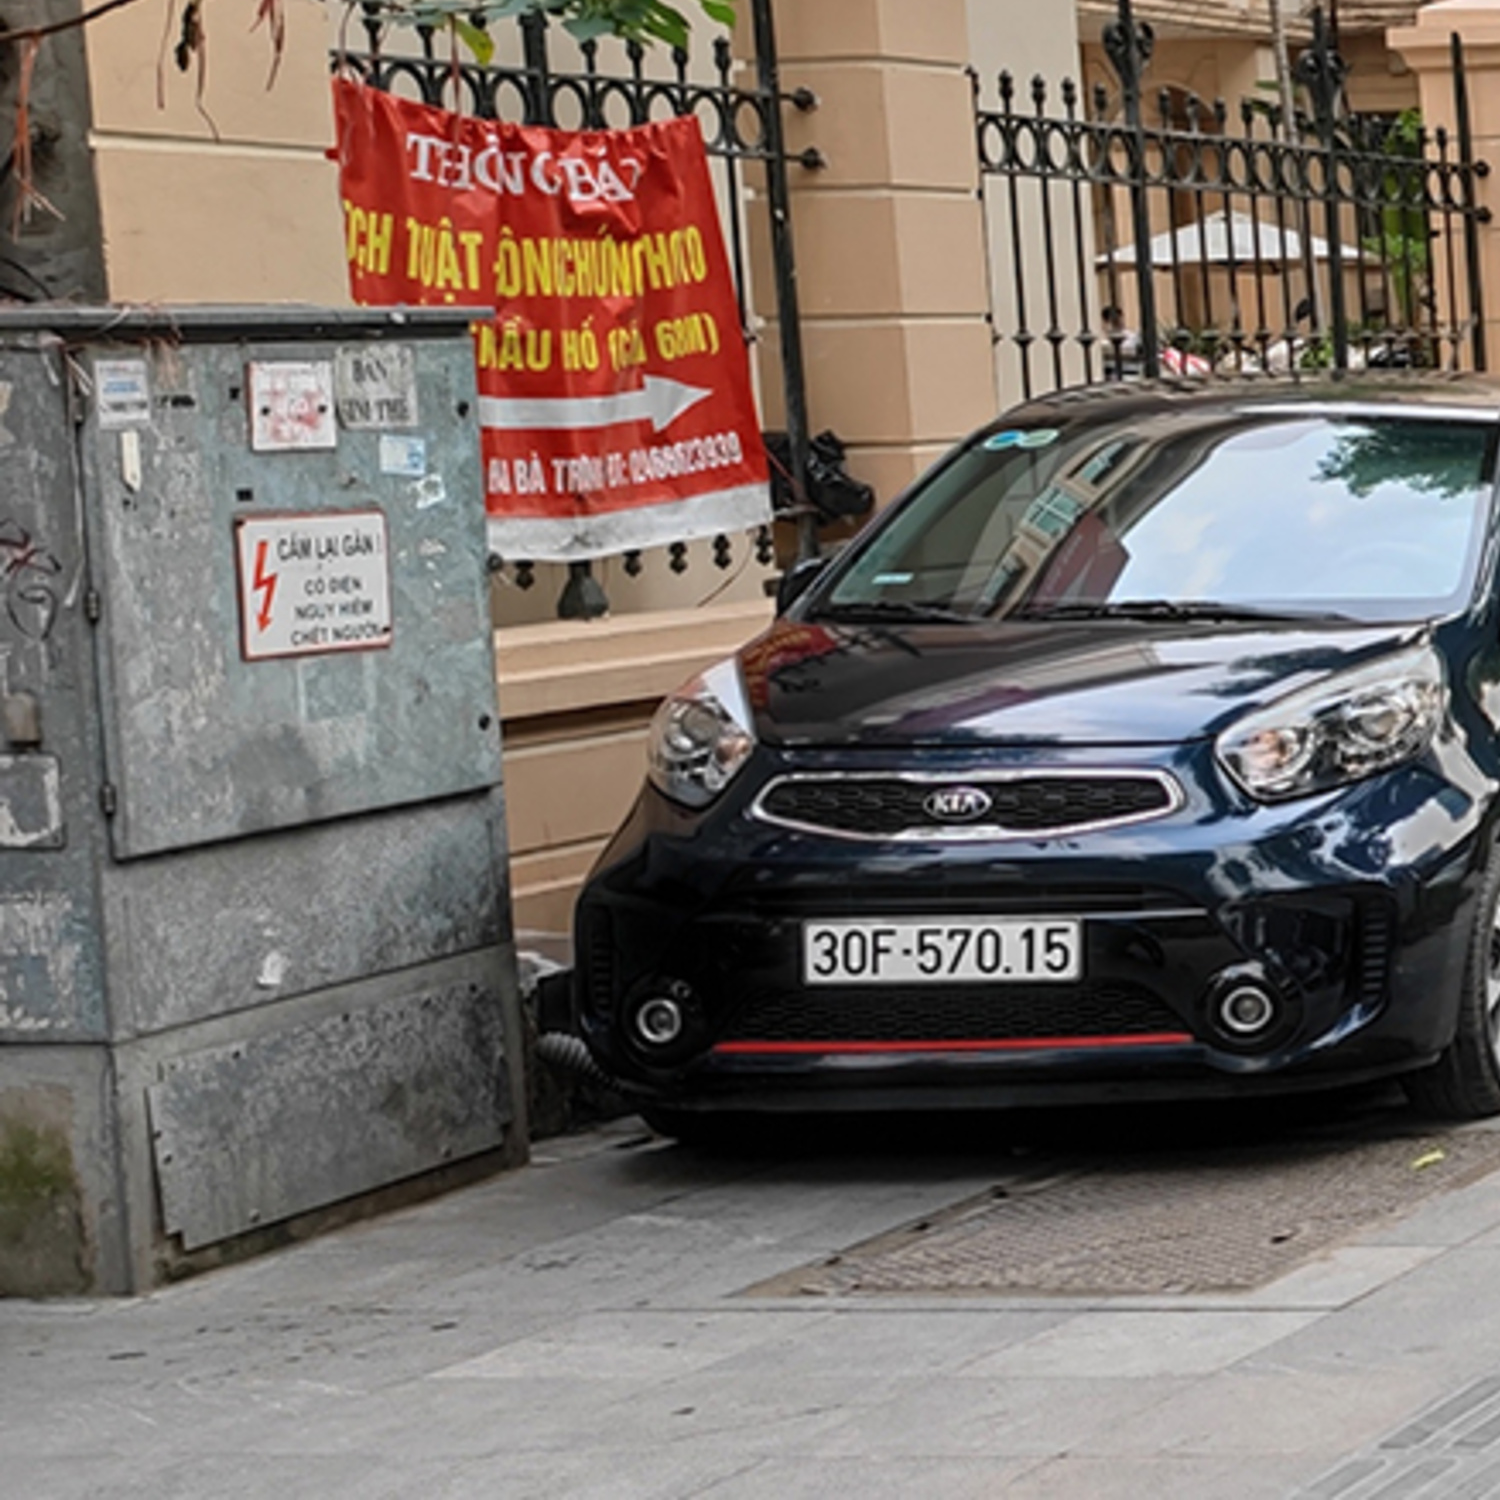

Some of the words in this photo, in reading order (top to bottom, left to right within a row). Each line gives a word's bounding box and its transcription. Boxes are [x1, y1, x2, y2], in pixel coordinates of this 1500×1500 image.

[513, 451, 547, 494] BÀ
[932, 792, 979, 813] KIA
[811, 927, 1071, 976] 30F-570.15
